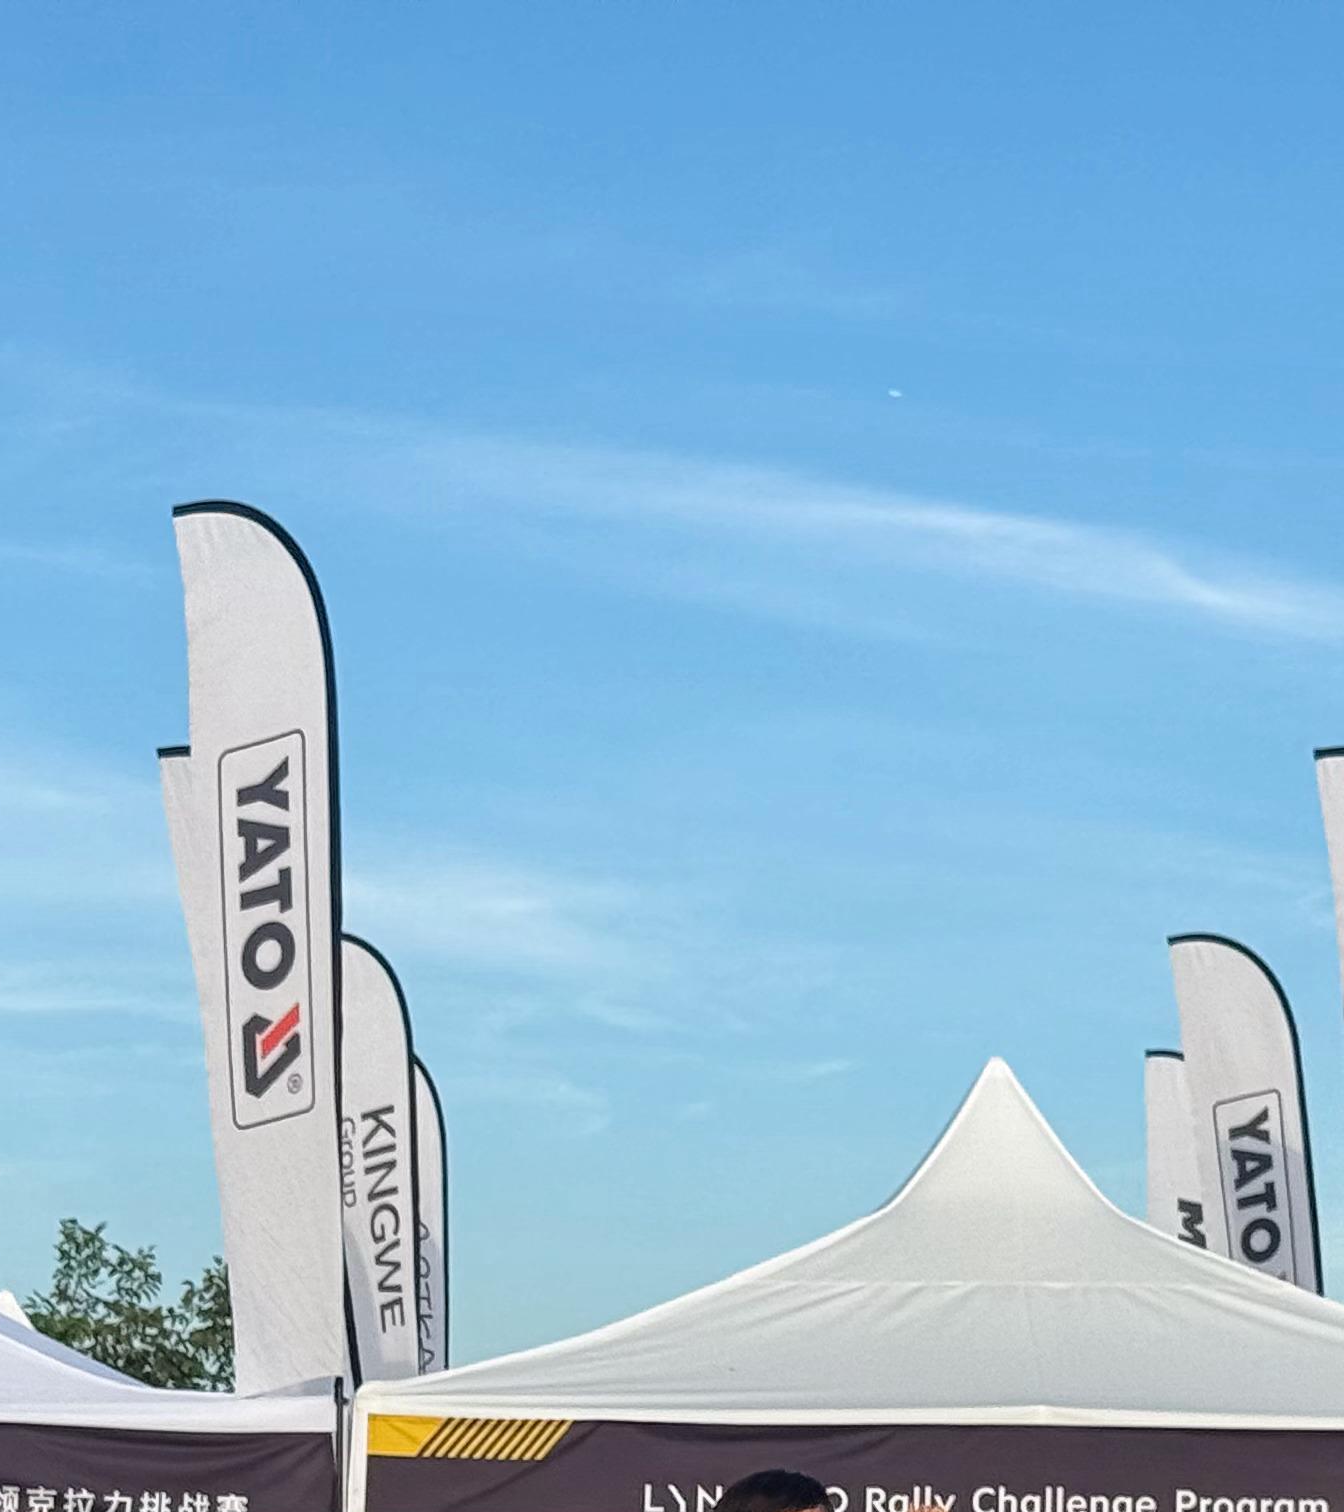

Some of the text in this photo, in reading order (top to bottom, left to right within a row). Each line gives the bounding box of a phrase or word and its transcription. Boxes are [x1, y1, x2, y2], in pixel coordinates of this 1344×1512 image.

[235, 756, 295, 990] YATO
[360, 1105, 406, 1334] KINGWE
[1228, 1105, 1282, 1264] YATO
